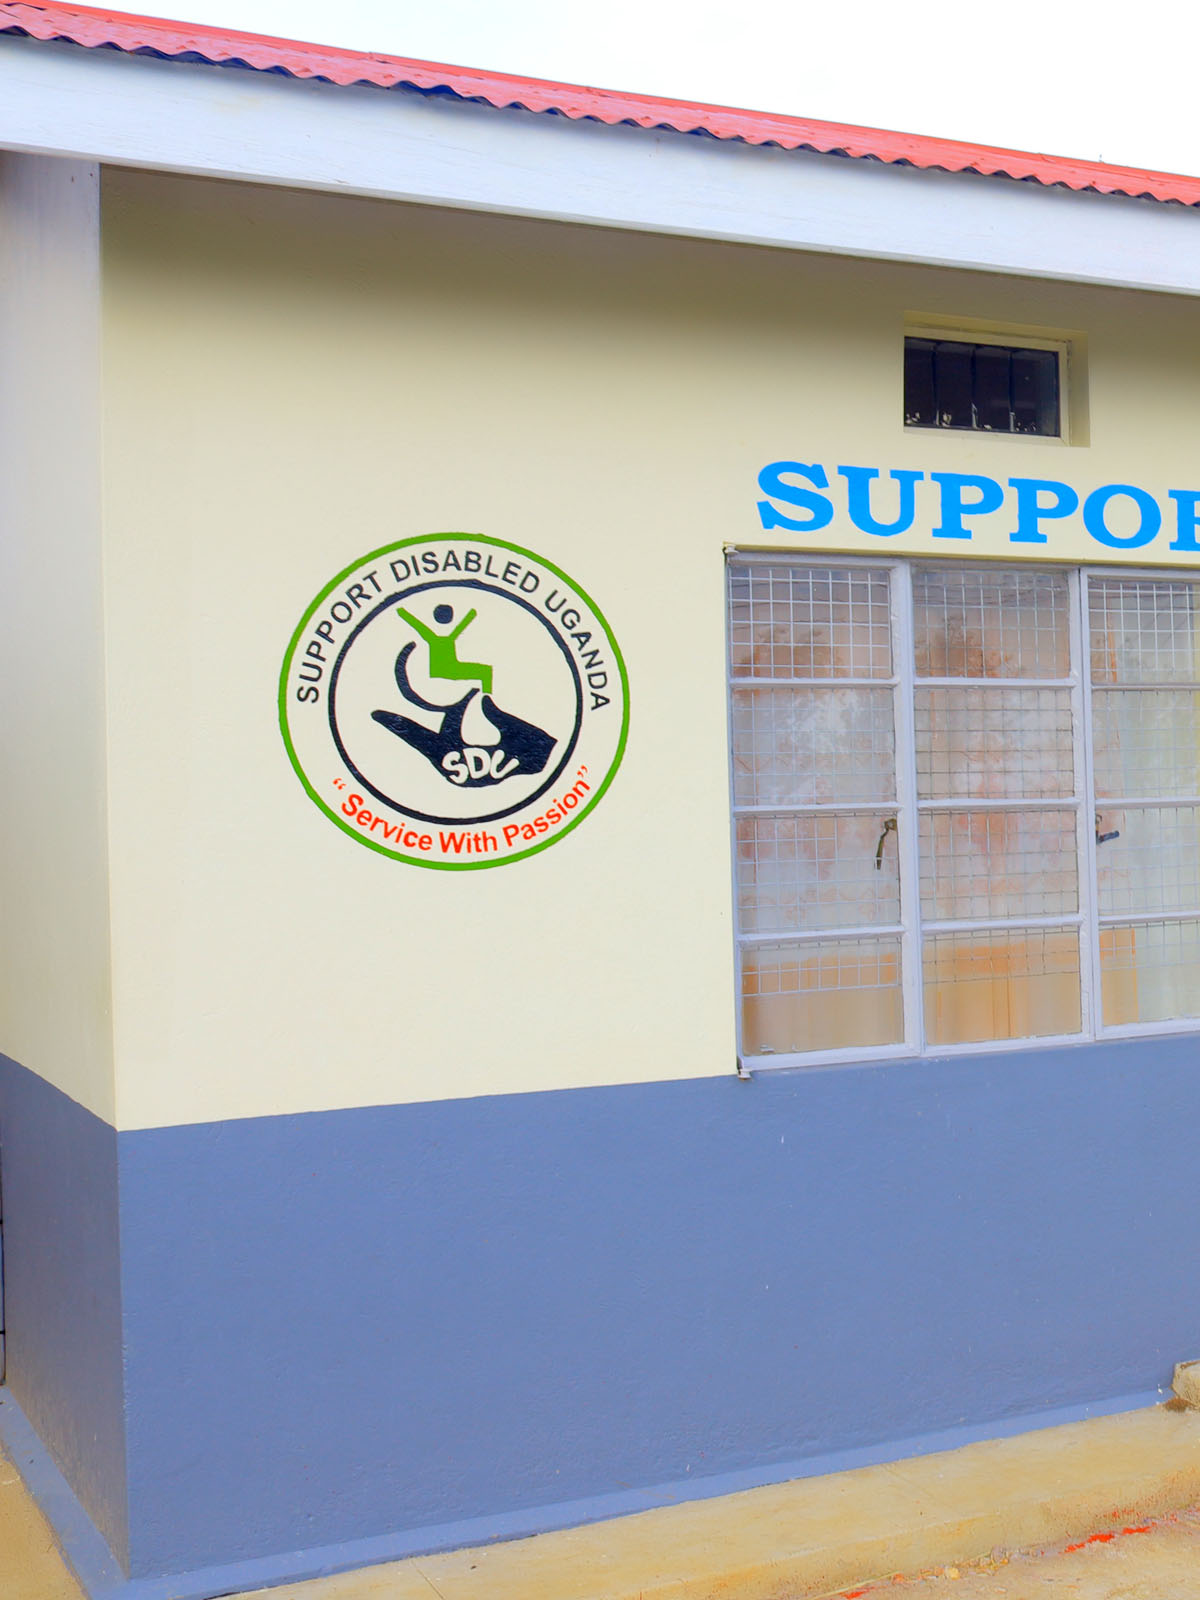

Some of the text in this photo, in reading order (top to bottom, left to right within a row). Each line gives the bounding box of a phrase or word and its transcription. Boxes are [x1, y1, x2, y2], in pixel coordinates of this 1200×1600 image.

[296, 549, 610, 711] SUPPORT DISABLED UGANDA
[441, 747, 520, 784] SDU
[439, 831, 498, 854] With
